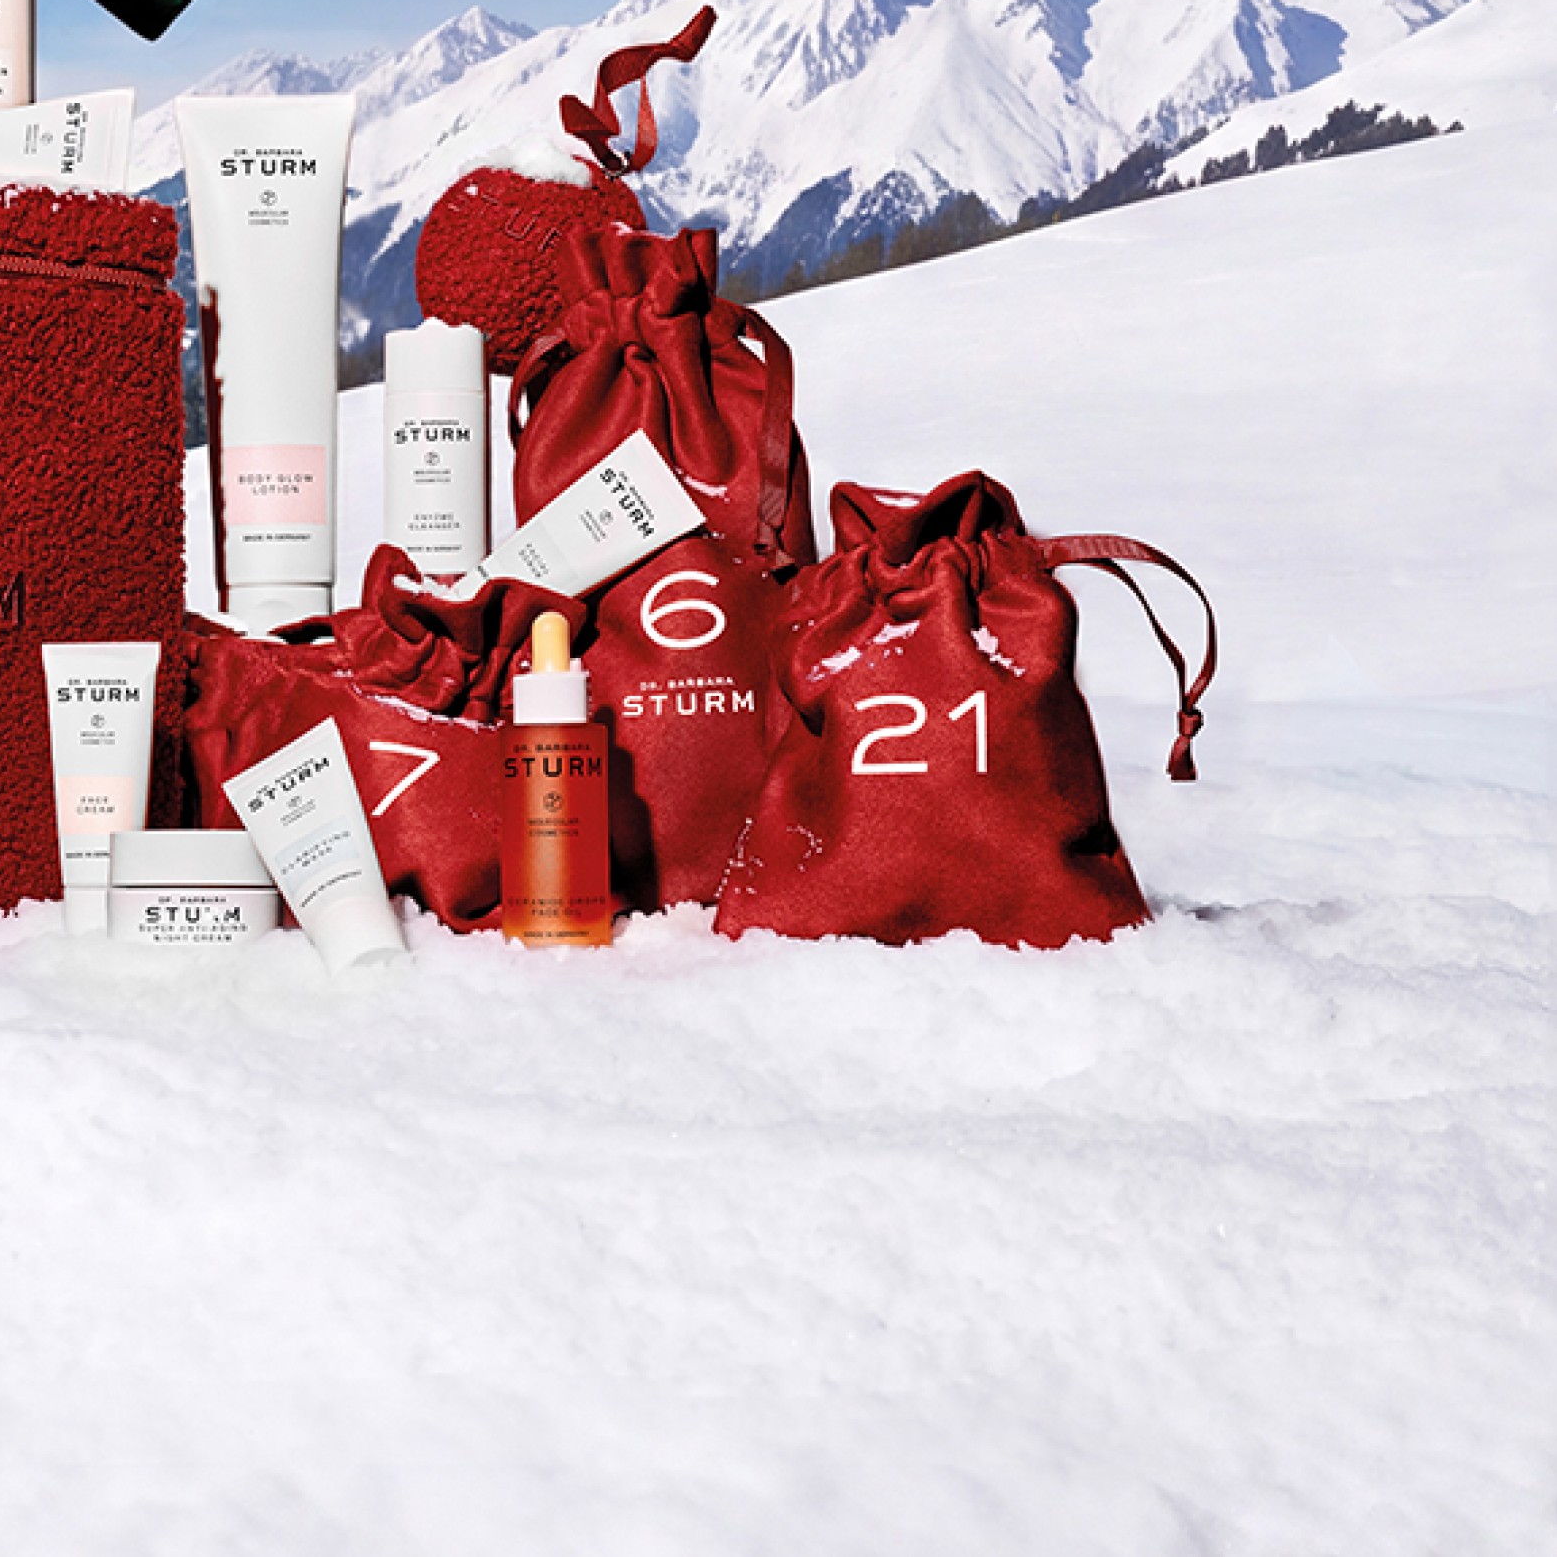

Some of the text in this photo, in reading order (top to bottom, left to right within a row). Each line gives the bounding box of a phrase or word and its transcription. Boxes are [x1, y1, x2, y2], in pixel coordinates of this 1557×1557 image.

[60, 102, 81, 174] STURM
[220, 159, 317, 177] STURM
[394, 427, 471, 444] STURM
[599, 468, 655, 539] STURM
[639, 570, 727, 650] 6
[57, 687, 141, 702] STURM
[667, 675, 736, 690] BARBARA
[622, 689, 755, 717] STURM
[851, 690, 988, 776] 21
[369, 740, 441, 817] 7
[503, 756, 603, 778] STURM
[248, 757, 330, 813] STURM
[145, 906, 241, 924] STUM
